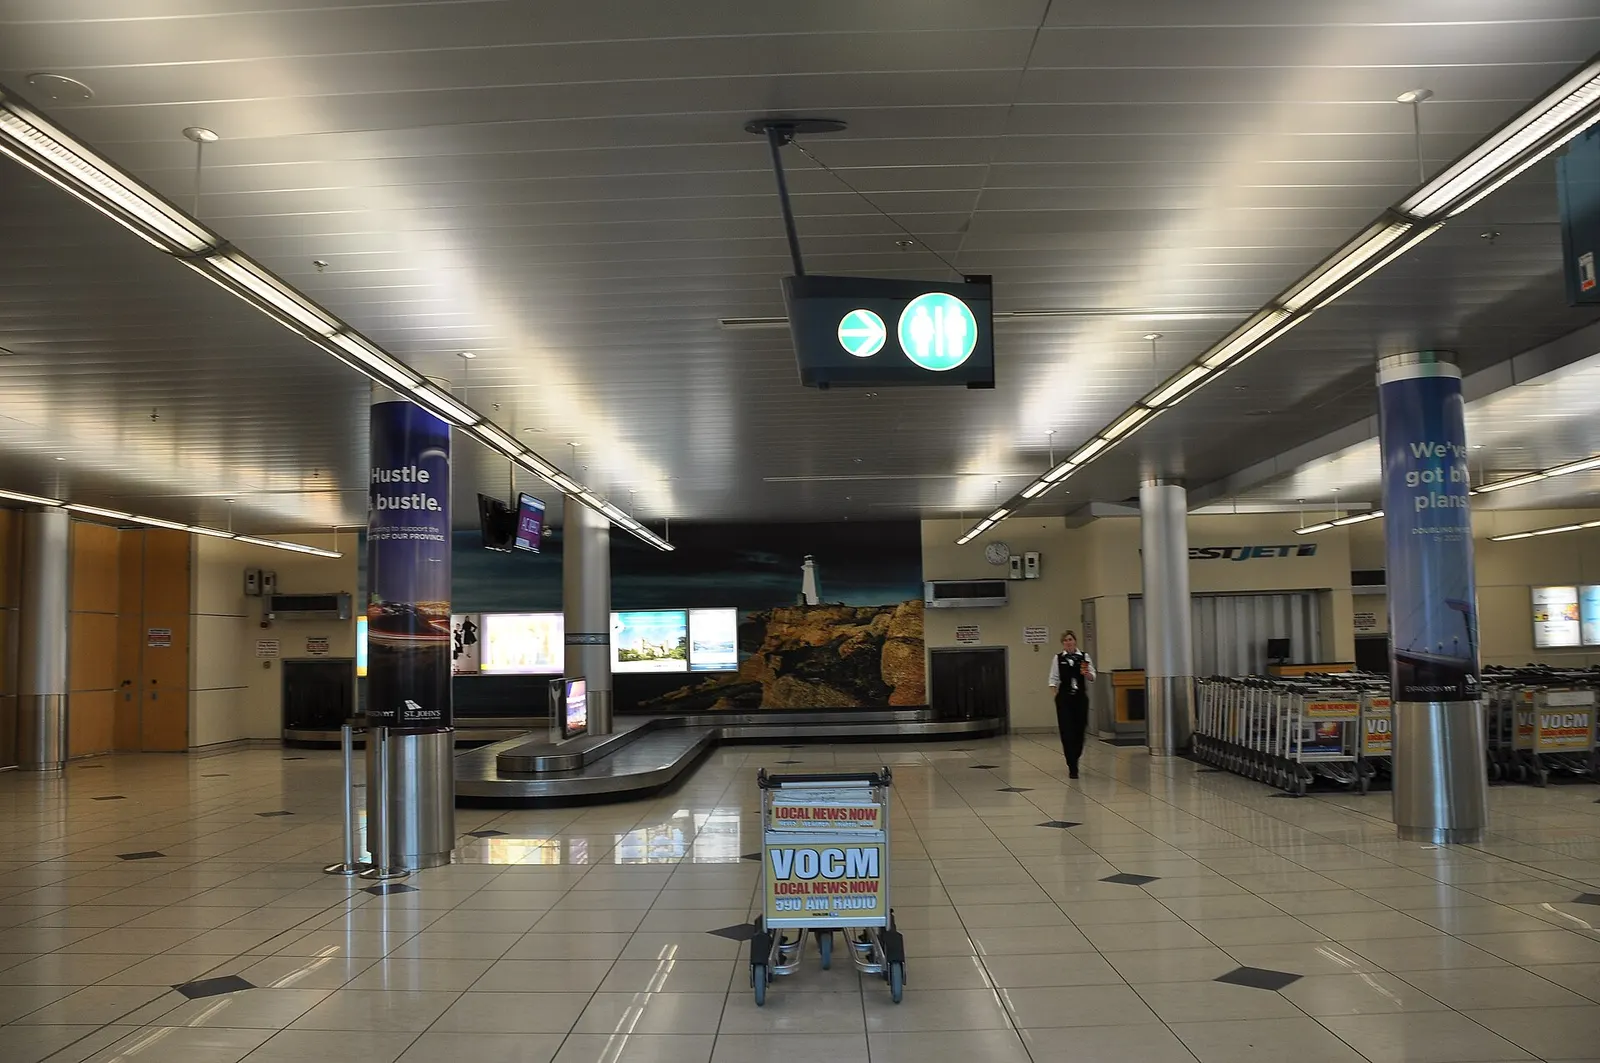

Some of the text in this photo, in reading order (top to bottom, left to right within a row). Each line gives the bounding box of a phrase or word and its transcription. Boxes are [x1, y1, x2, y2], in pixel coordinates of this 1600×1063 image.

[1410, 440, 1467, 459] We've
[371, 466, 430, 484] Hustle
[1406, 467, 1444, 488] got
[376, 494, 442, 512] bustle.
[392, 533, 409, 541] OUR
[1189, 544, 1298, 562] ESTJET
[1367, 719, 1391, 734] VO
[1540, 713, 1589, 729] VOCM
[775, 807, 878, 821] LOCAL NEWS NOW
[770, 848, 879, 880] VOCM
[774, 881, 878, 895] LOCAL NEWS NOW
[775, 895, 876, 912] 590 AM RADIO
